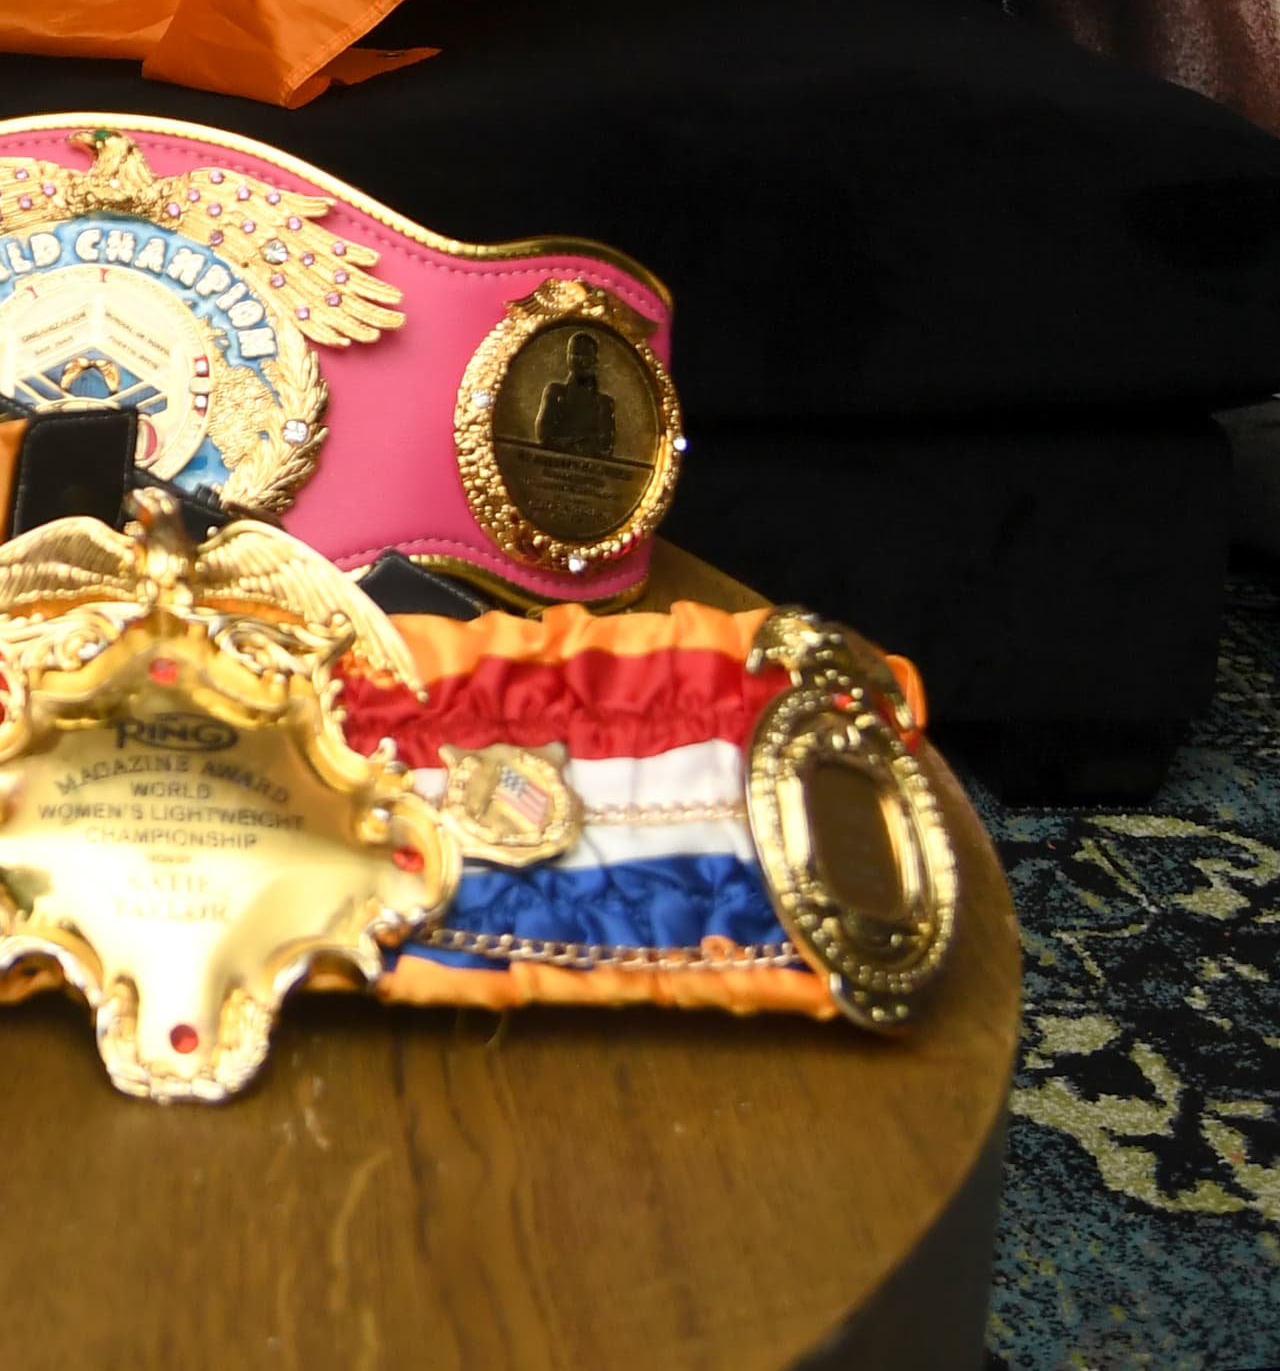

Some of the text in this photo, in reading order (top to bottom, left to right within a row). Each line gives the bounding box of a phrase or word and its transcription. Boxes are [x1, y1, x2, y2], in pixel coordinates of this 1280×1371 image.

[74, 228, 276, 358] CHAMPION
[54, 755, 289, 804] MAGAZINE AWARD
[130, 780, 212, 799] WORLD
[39, 803, 306, 830] WOMEN'S LIGHTWEIGHT
[85, 827, 258, 849] CHAMPIONSHIP
